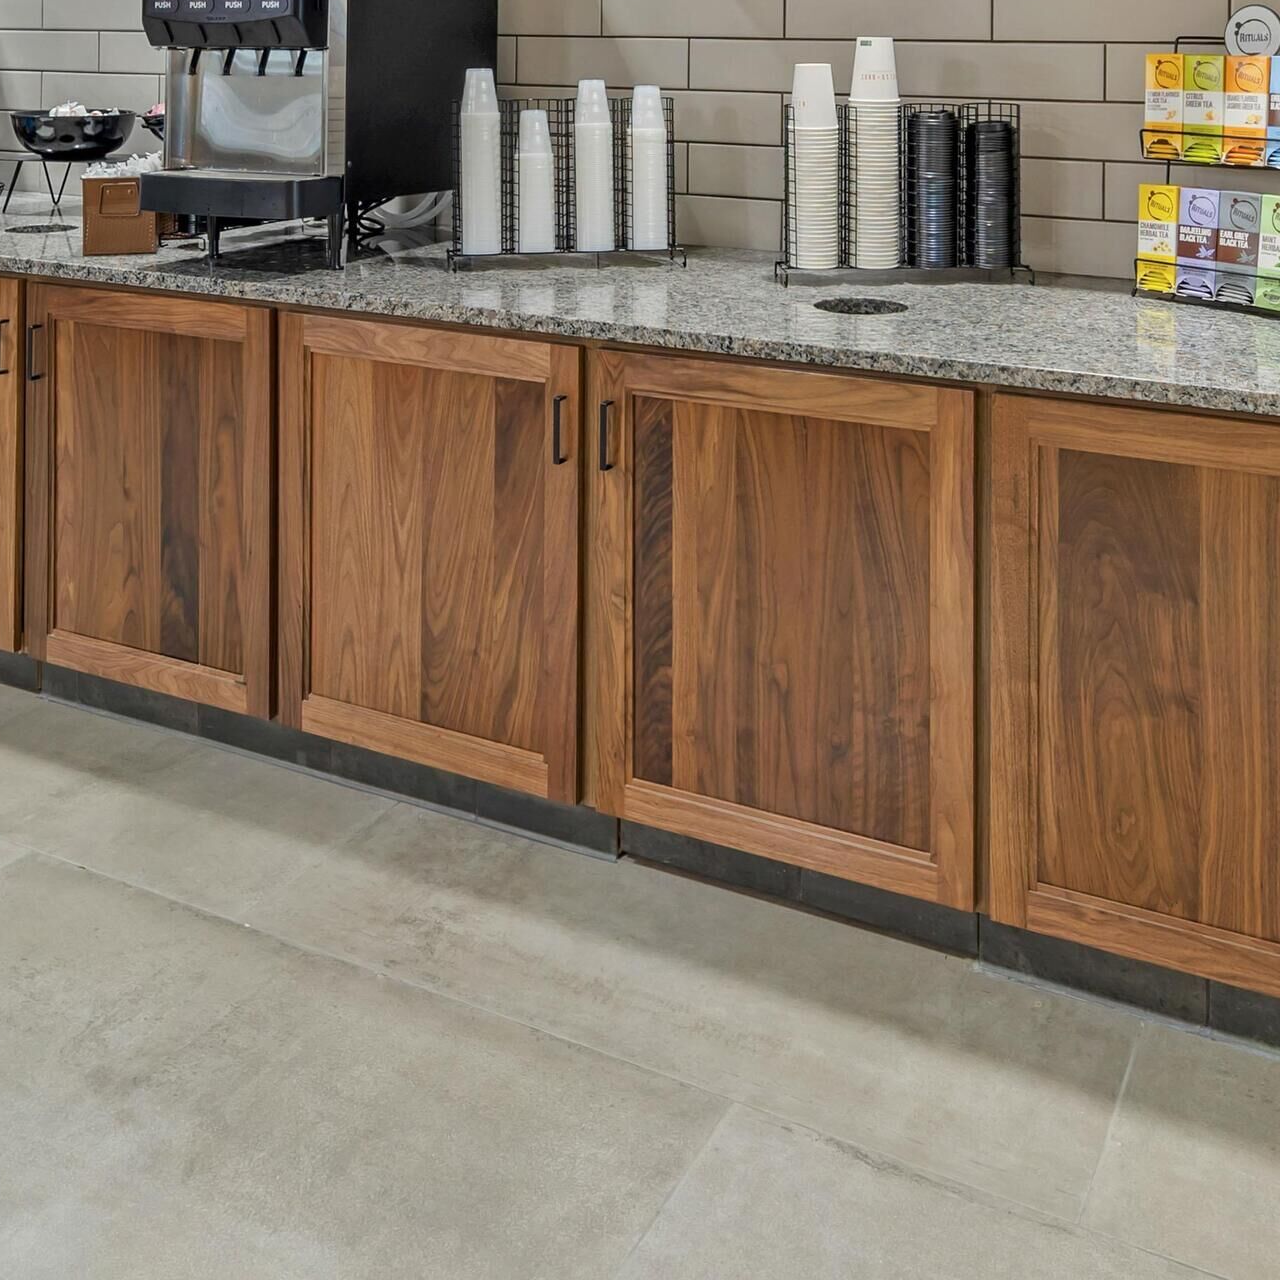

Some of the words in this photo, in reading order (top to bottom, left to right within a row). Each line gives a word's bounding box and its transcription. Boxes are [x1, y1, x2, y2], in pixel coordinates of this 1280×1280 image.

[189, 1, 206, 9] PUSH
[225, 1, 242, 9] PUSH
[1240, 32, 1268, 42] RITUALS
[1238, 71, 1260, 84] RITUALS
[1150, 200, 1170, 214] RITUALS
[1191, 204, 1213, 218] RITUALS
[1233, 207, 1254, 223] RITUALS
[1180, 233, 1196, 242] BLACK
[1196, 235, 1207, 244] TEA
[1220, 230, 1234, 238] EARL
[1262, 235, 1277, 243] MINT
[1219, 238, 1238, 247] BLACK
[1238, 240, 1249, 249] TEA
